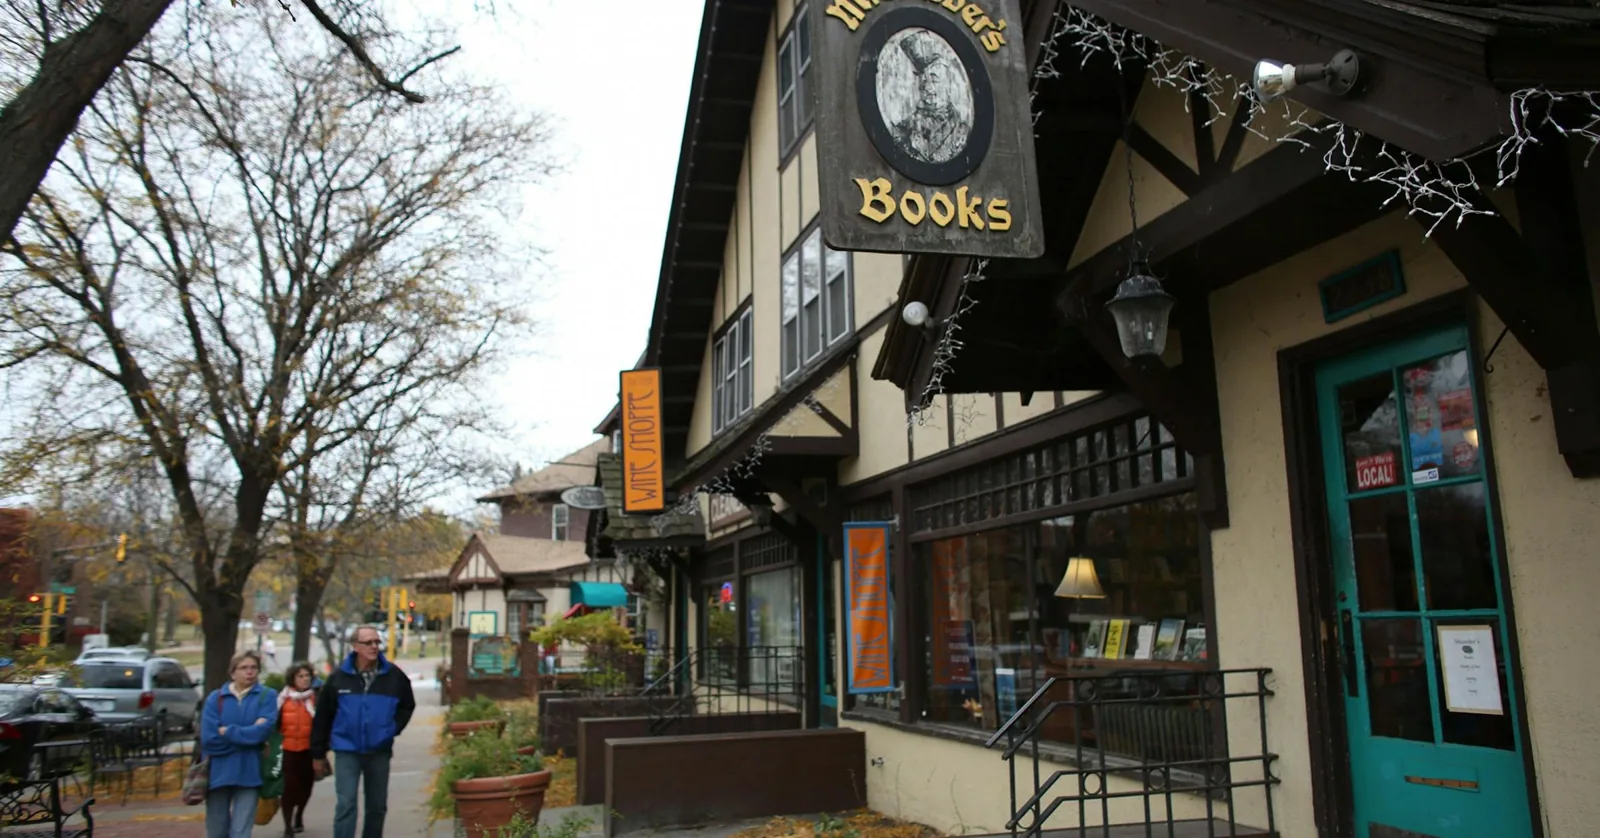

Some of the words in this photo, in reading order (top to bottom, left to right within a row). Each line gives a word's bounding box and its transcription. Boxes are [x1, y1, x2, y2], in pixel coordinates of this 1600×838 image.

[852, 177, 1012, 231] Books
[627, 390, 656, 454] SHOPPE
[630, 460, 658, 504] WINE
[1357, 463, 1394, 488] LOCAL!
[852, 546, 886, 625] SHOPPE
[854, 631, 887, 685] WINE
